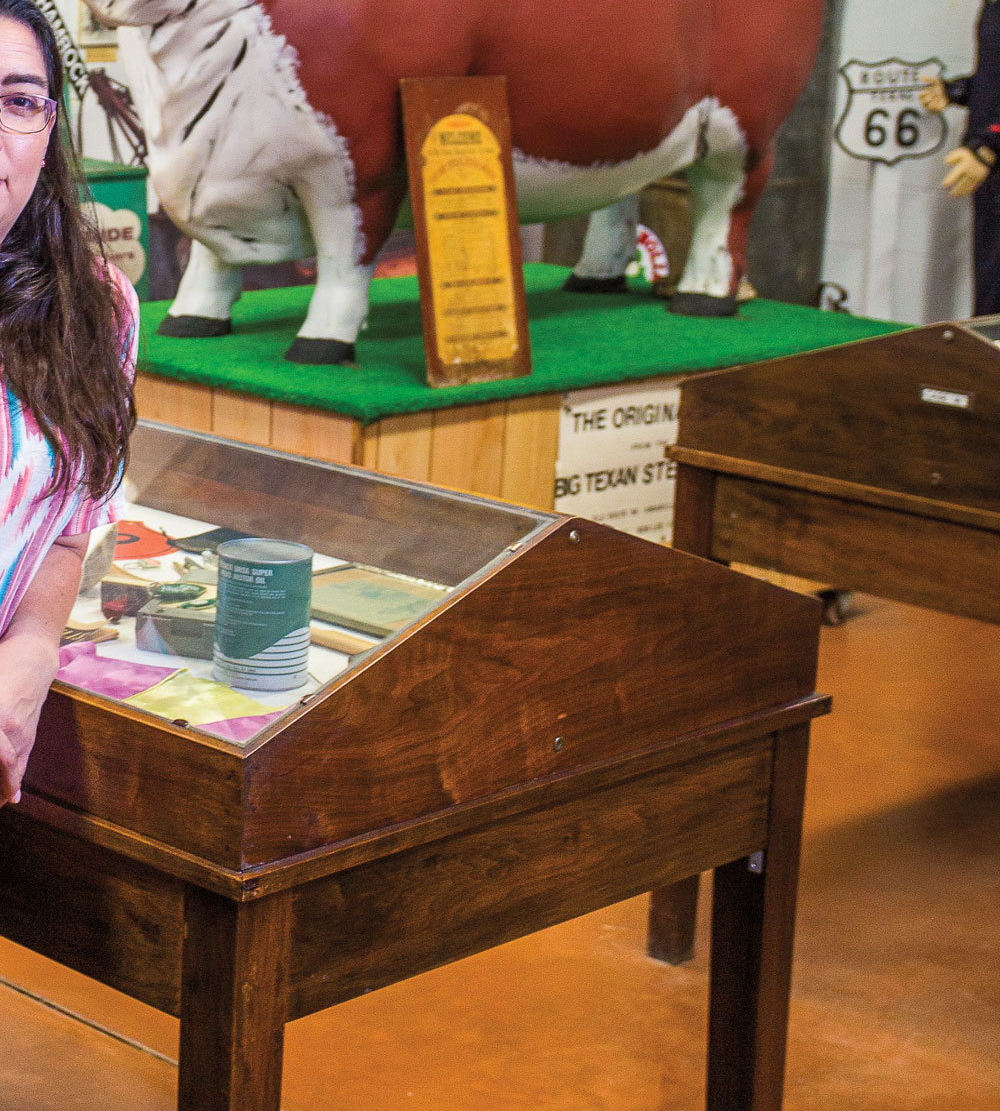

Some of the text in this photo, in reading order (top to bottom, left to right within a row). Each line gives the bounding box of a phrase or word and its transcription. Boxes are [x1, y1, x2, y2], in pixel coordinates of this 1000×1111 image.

[865, 107, 920, 148] 66
[572, 402, 680, 433] THE ORIGIN
[554, 474, 581, 499] BIG
[585, 465, 639, 493] TEXAN
